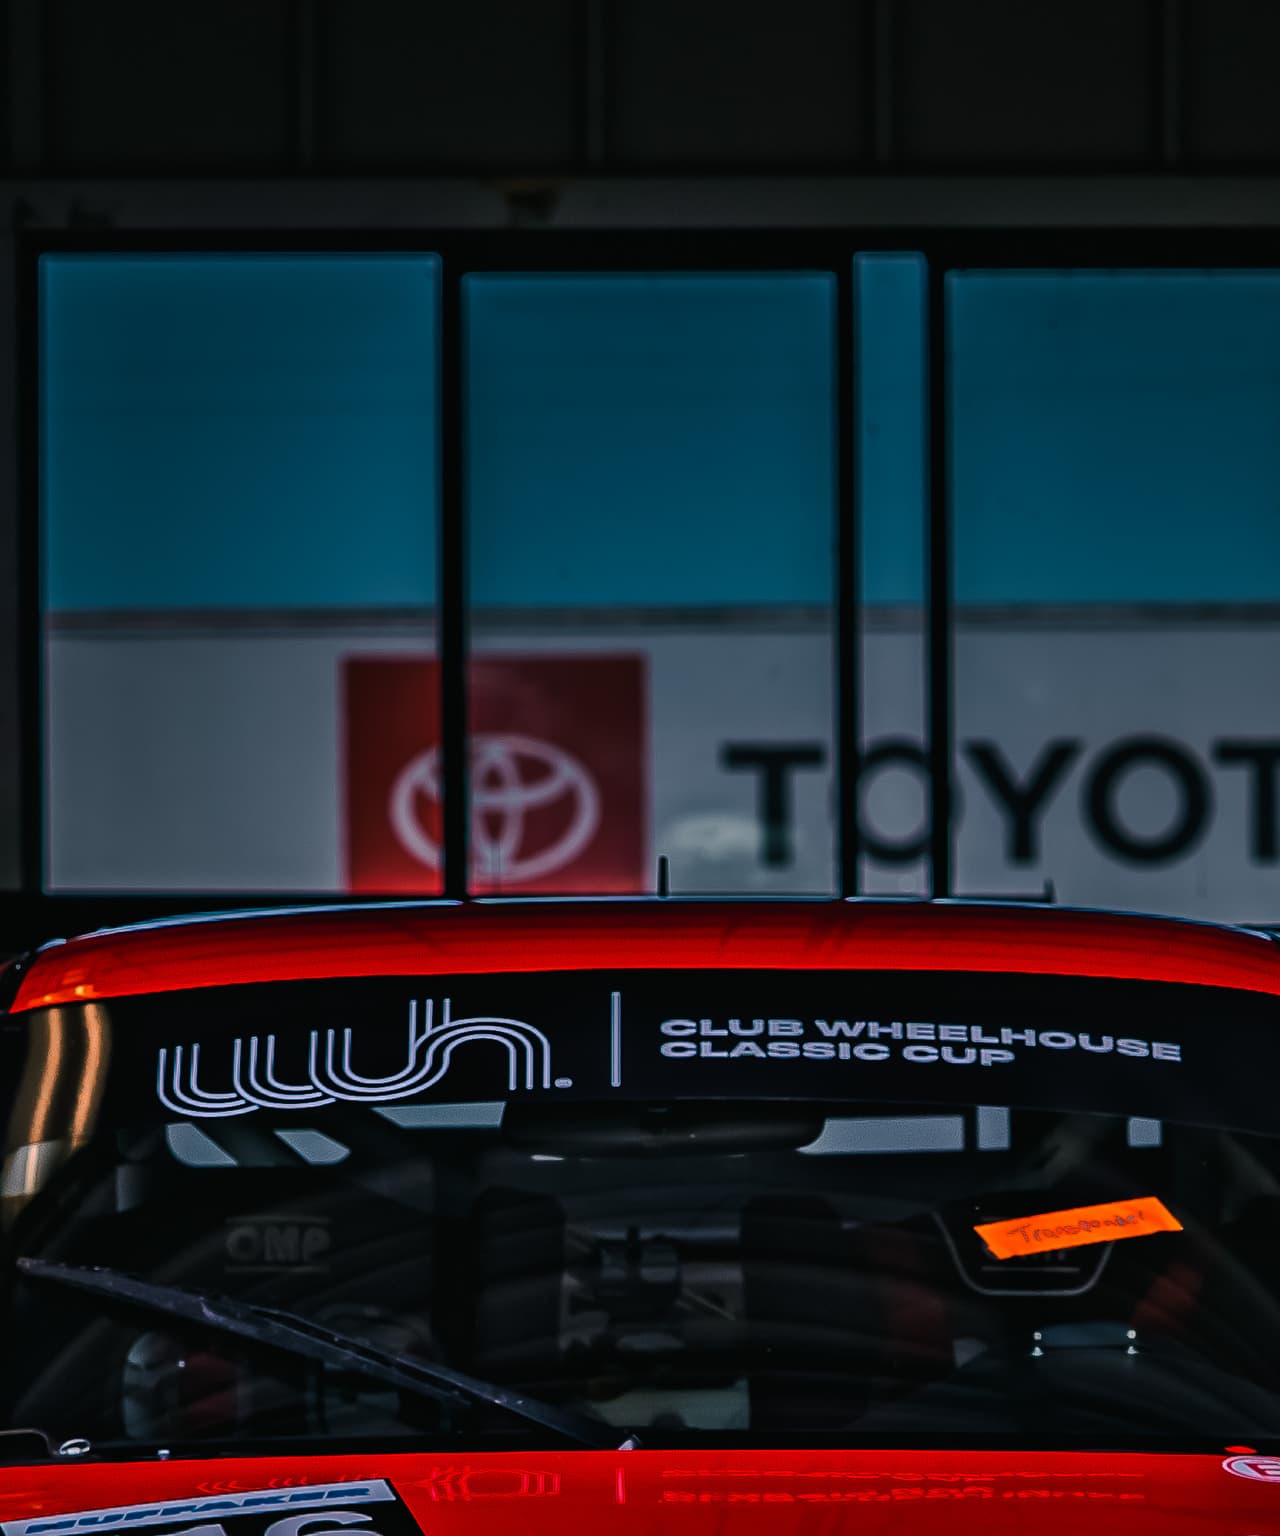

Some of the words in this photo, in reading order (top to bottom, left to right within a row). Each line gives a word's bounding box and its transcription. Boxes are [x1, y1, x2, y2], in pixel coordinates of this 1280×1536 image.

[659, 1018, 804, 1037] CLUB
[815, 1019, 1183, 1063] WHEELHOUSE
[659, 1041, 891, 1062] CLASSIC
[901, 1043, 1016, 1067] CUP
[224, 1225, 333, 1263] OMP
